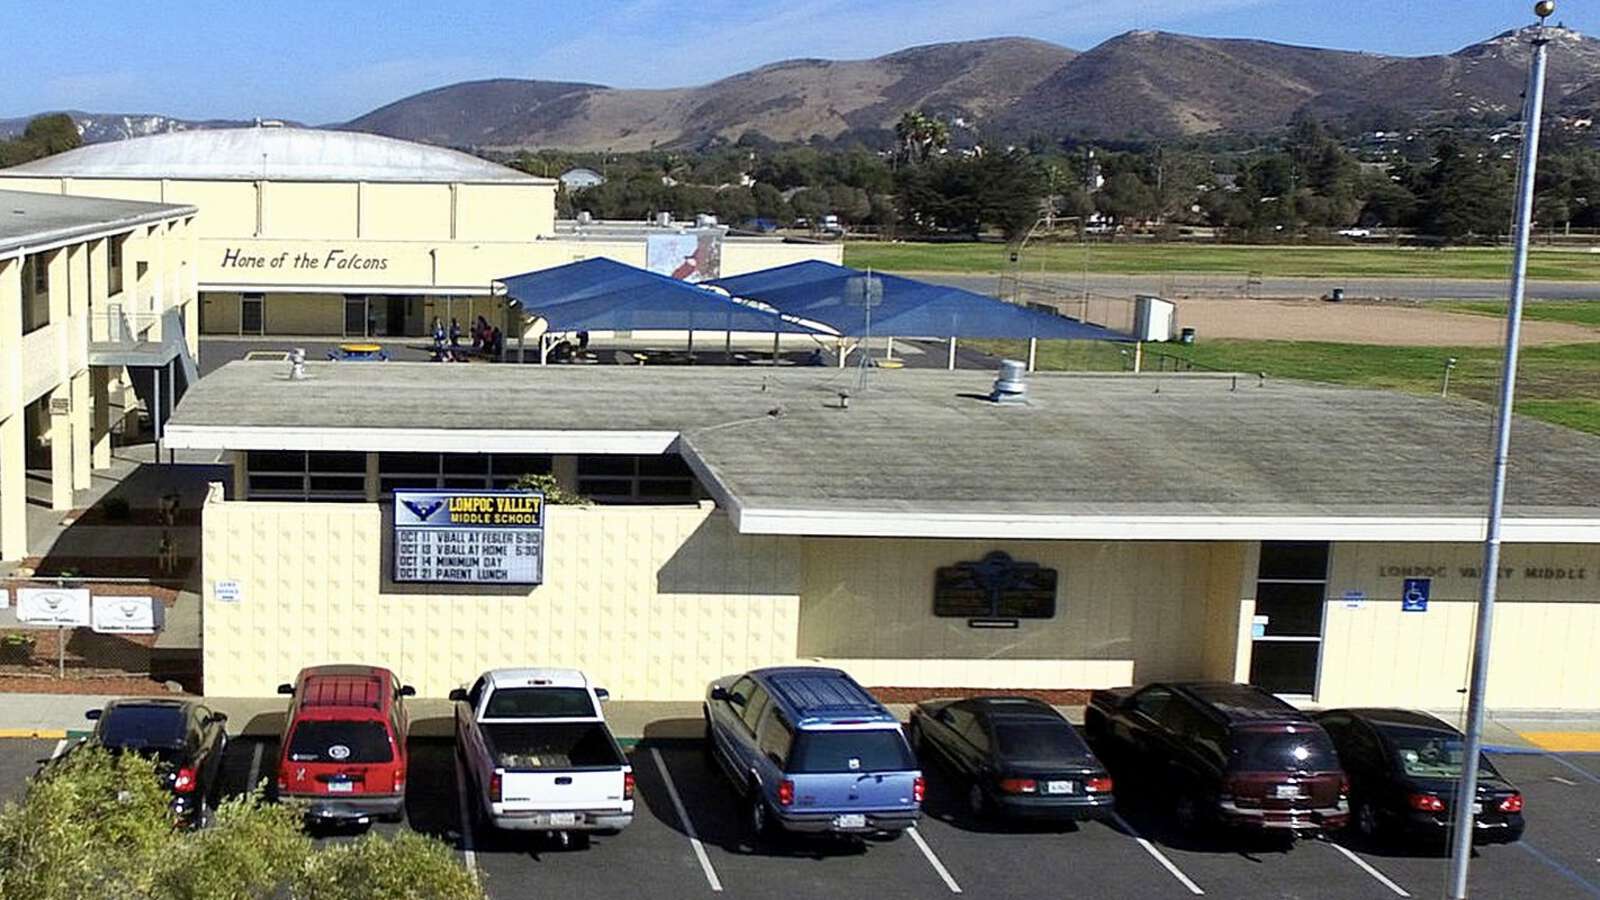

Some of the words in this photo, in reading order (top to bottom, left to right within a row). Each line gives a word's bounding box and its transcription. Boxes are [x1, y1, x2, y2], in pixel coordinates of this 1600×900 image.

[221, 248, 265, 268] Home
[270, 252, 289, 269] of
[294, 252, 319, 269] the
[323, 249, 388, 270] Falcons
[449, 498, 494, 512] LOMPOC
[496, 499, 540, 513] VALLEY
[451, 513, 491, 523] MIDDLE
[494, 514, 538, 524] SCHOOL
[400, 532, 418, 543] OCT
[422, 532, 431, 543] 11
[468, 533, 479, 544] AT
[400, 544, 418, 555] OCT
[422, 544, 431, 555] 13
[468, 545, 479, 556] AT
[482, 545, 508, 556] HOME
[400, 556, 418, 567] OCT
[422, 556, 431, 567] 14
[436, 557, 480, 568] MINIMUM
[483, 557, 502, 568] DAY
[400, 568, 418, 579] OCT
[421, 569, 431, 579] 21
[436, 569, 473, 580] PARENT
[477, 569, 508, 580] LUNCH
[1525, 567, 1588, 580] MIDDLE
